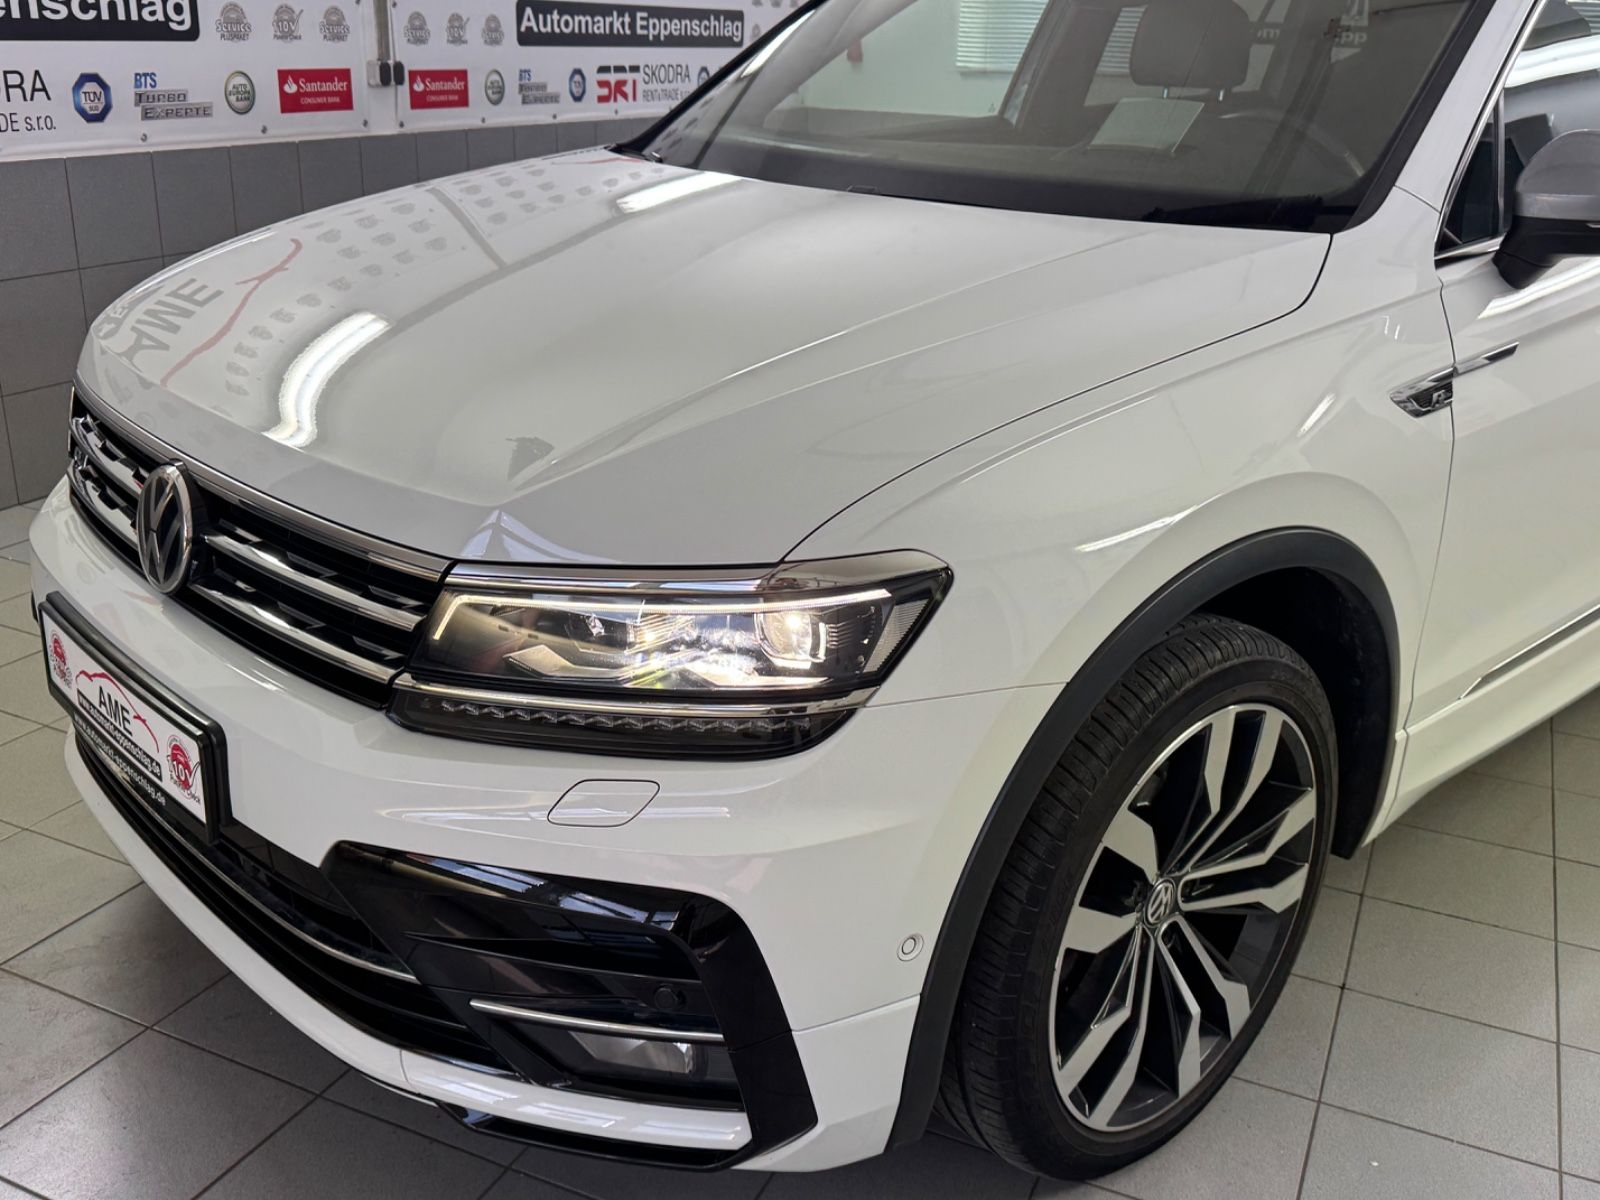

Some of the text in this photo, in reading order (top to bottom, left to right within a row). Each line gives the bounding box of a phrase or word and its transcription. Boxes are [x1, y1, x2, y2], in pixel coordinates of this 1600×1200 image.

[0, 0, 192, 31] nschlag
[520, 7, 743, 42] Automarkt Eppenschlag
[134, 72, 157, 89] BTS
[642, 64, 691, 85] SKODRA
[0, 69, 52, 102] RA
[299, 77, 348, 93] Santander
[425, 78, 465, 91] Santander
[135, 92, 187, 104] TURBO
[24, 114, 57, 132] s.r.o.
[98, 685, 133, 737] AME
